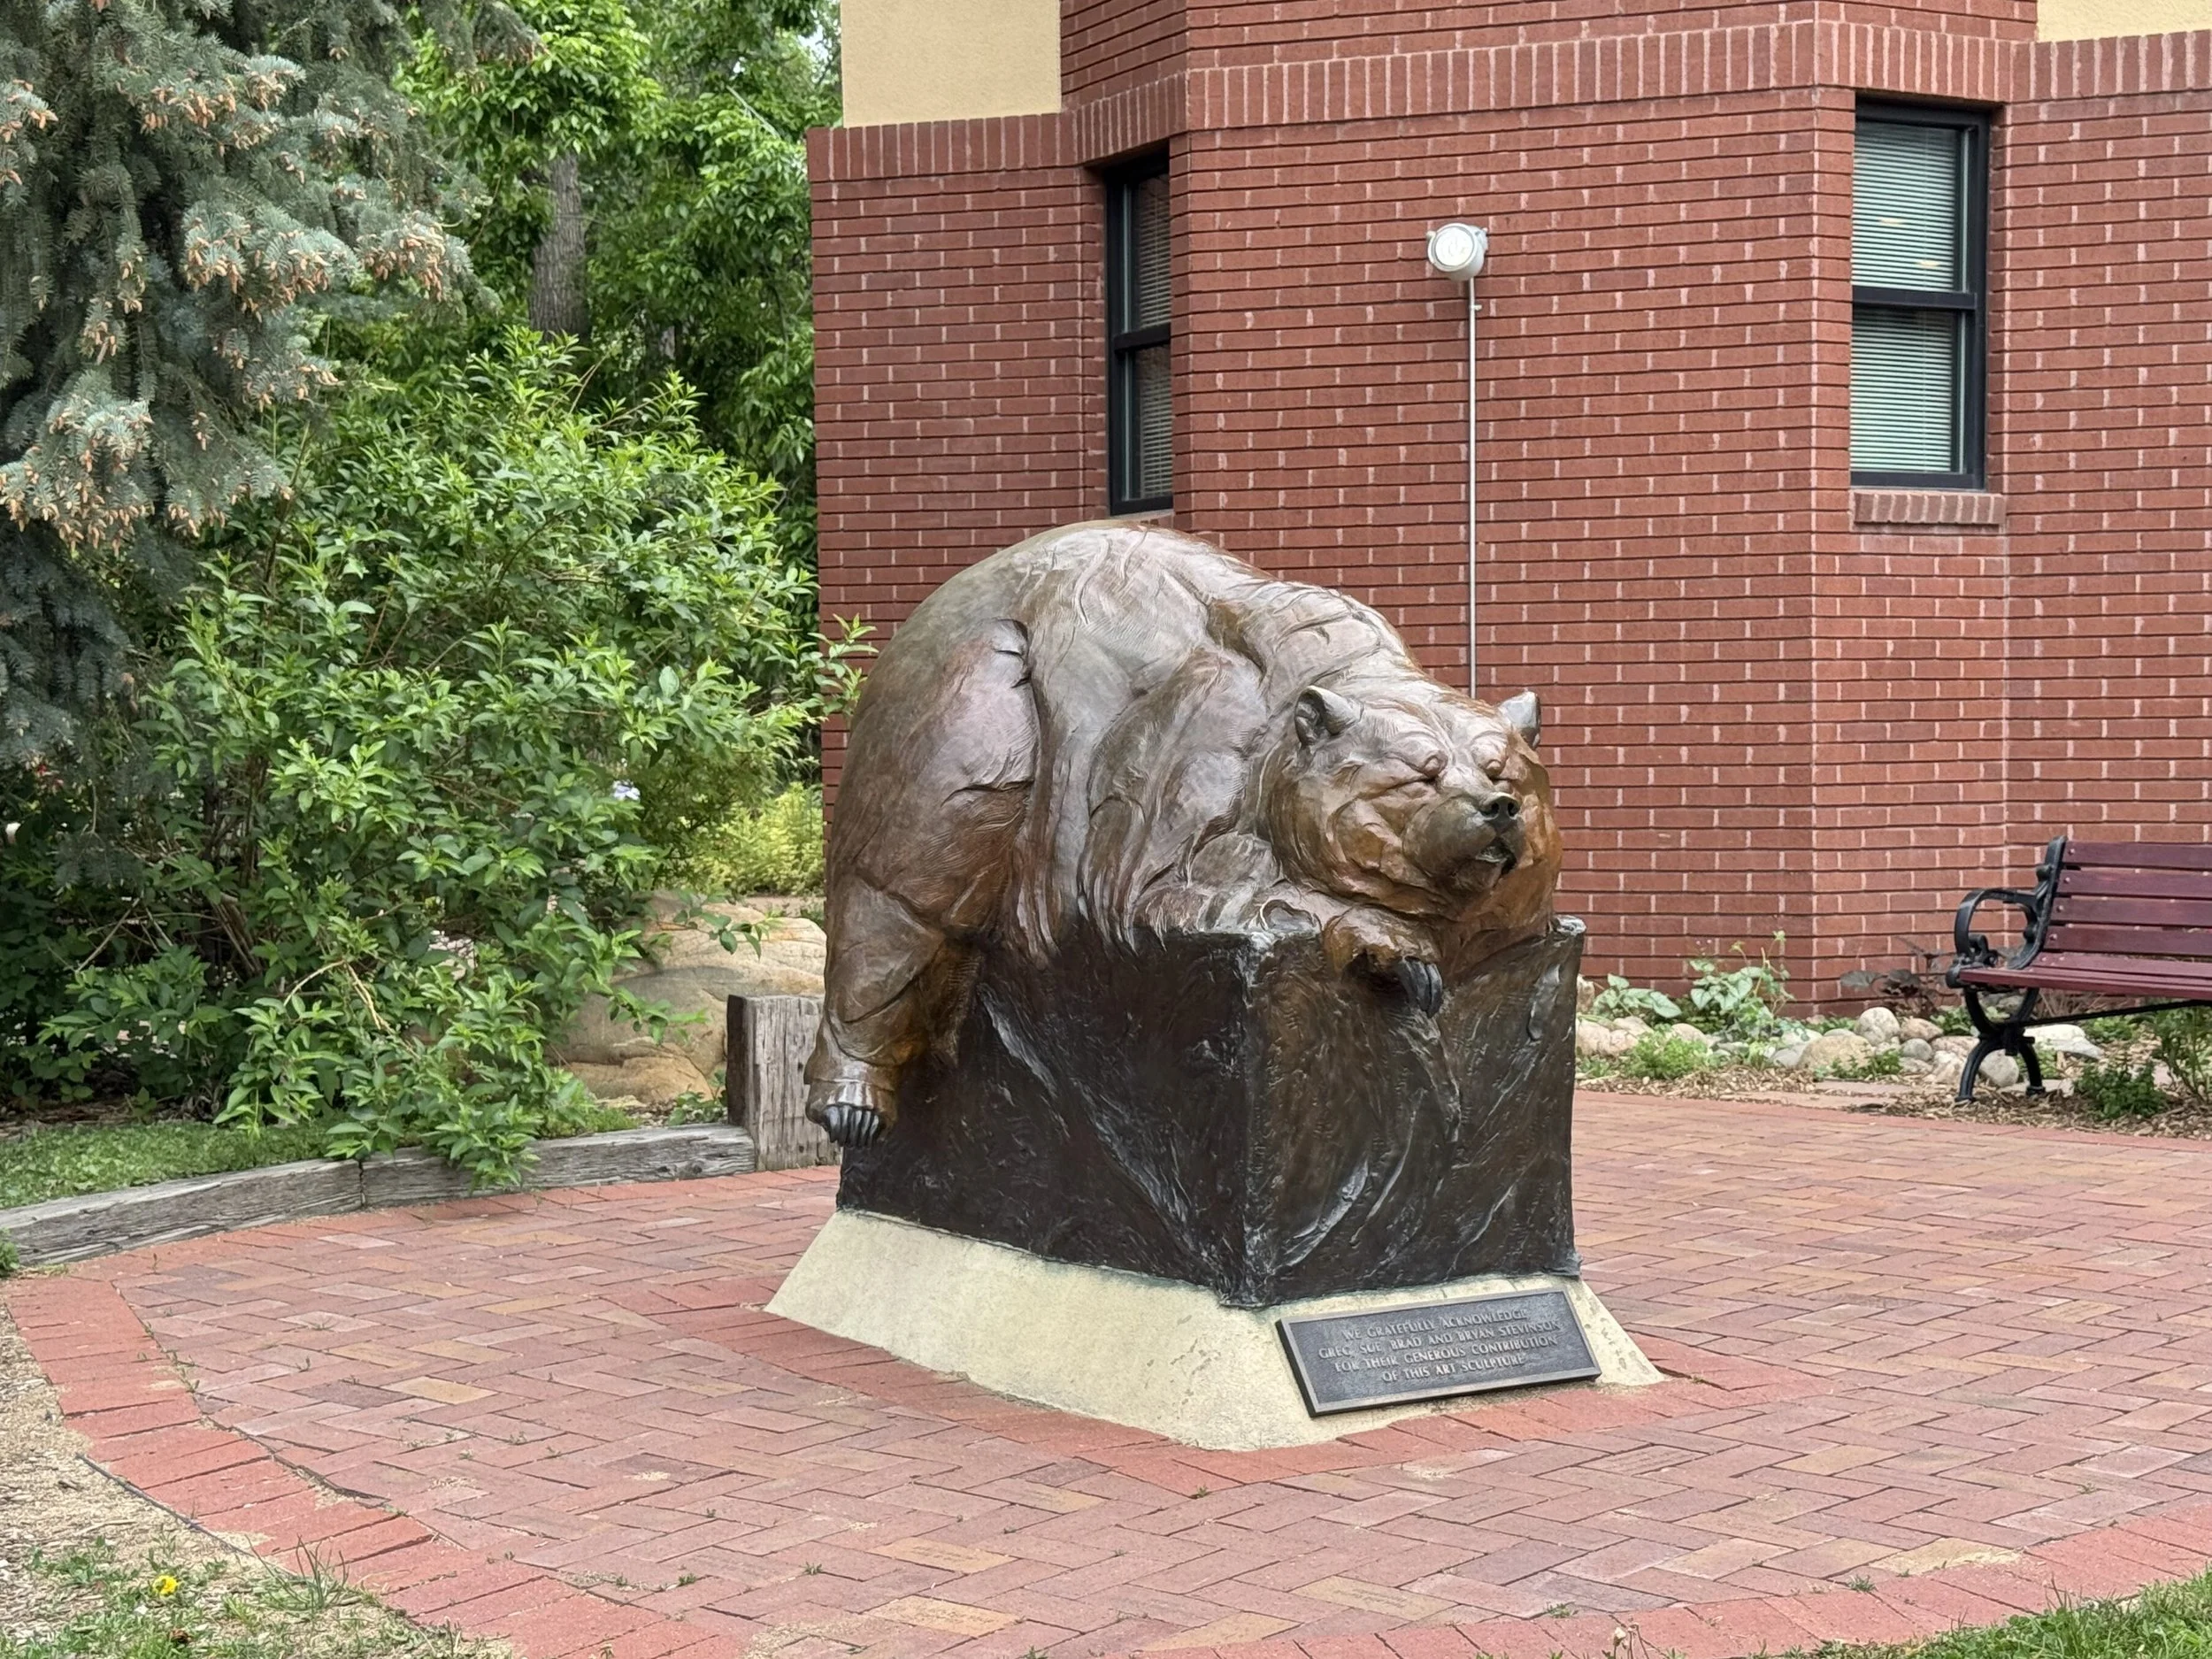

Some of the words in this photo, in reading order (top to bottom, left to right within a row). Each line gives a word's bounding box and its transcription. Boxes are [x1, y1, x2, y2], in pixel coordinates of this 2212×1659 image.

[1342, 1329, 1362, 1340] WE
[1367, 1319, 1434, 1338] GRATEFULLY
[1439, 1310, 1528, 1328] ACKNOWLEDGE
[1390, 1336, 1421, 1350] BRAD
[1429, 1333, 1452, 1345] AND
[1456, 1328, 1494, 1341] BRYAN
[1499, 1321, 1561, 1337] STEVINSON
[1335, 1361, 1359, 1372] FOR
[1364, 1355, 1399, 1369] THEIR
[1404, 1347, 1465, 1363] GENEROUS
[1471, 1336, 1558, 1355] CONTRIBUTION
[1382, 1371, 1398, 1383] OF
[1403, 1366, 1430, 1379] THIS
[1436, 1362, 1456, 1375] ART
[1462, 1353, 1525, 1372] SCULPTURE
